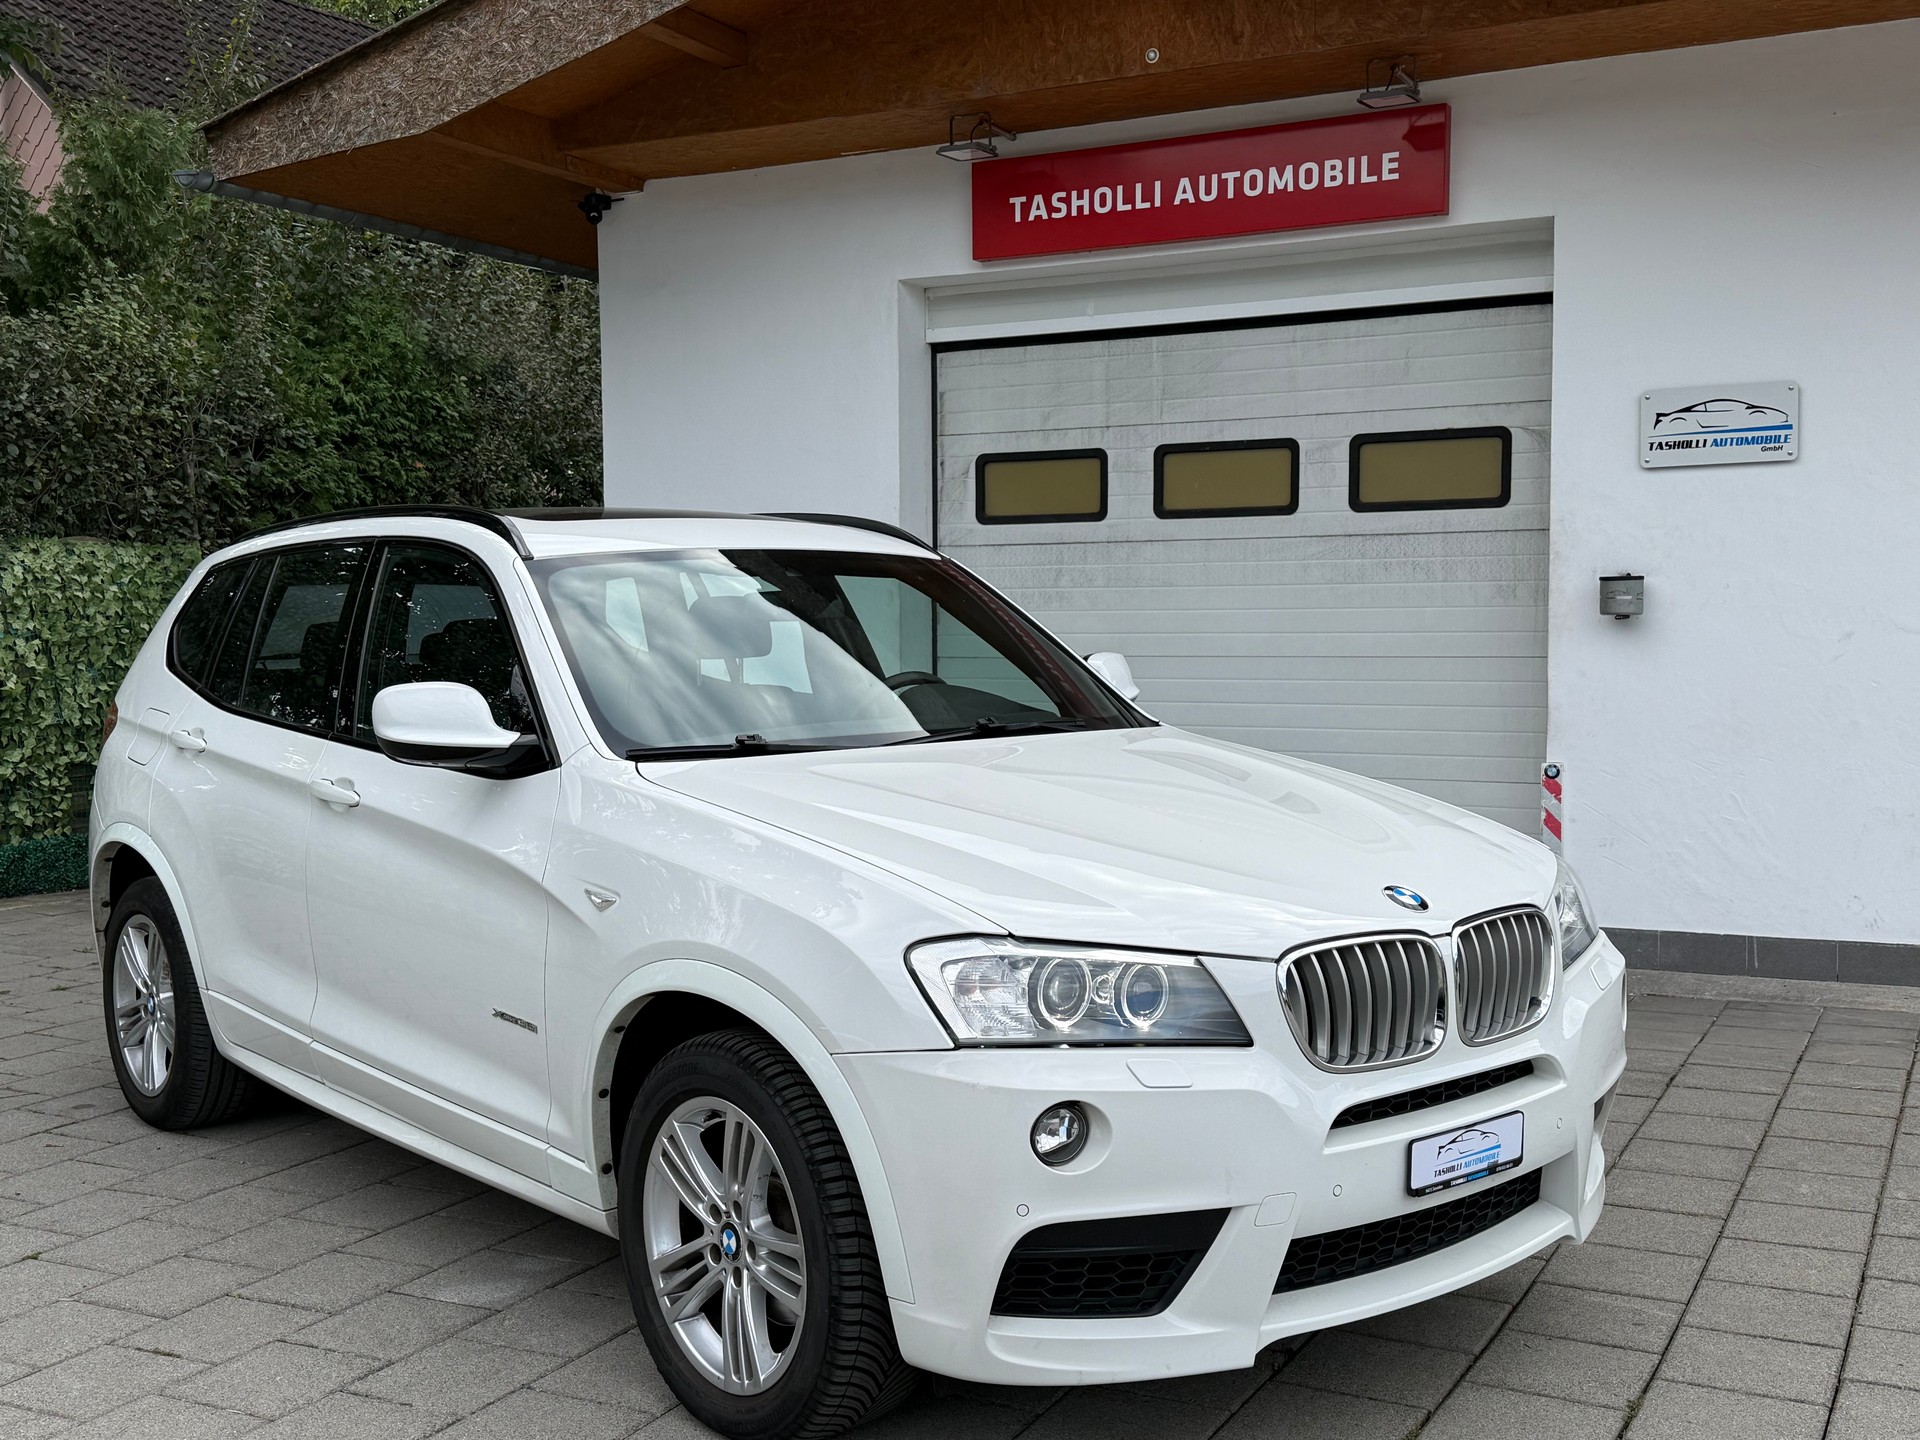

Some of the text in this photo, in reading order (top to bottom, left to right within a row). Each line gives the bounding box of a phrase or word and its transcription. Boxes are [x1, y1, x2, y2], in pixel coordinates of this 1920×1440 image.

[1009, 151, 1400, 223] TASHOLLI AUTOMOBILE
[1648, 434, 1792, 451] TASHOLLI AUTOMOBILE
[1434, 1162, 1463, 1178] TASHOLLI
